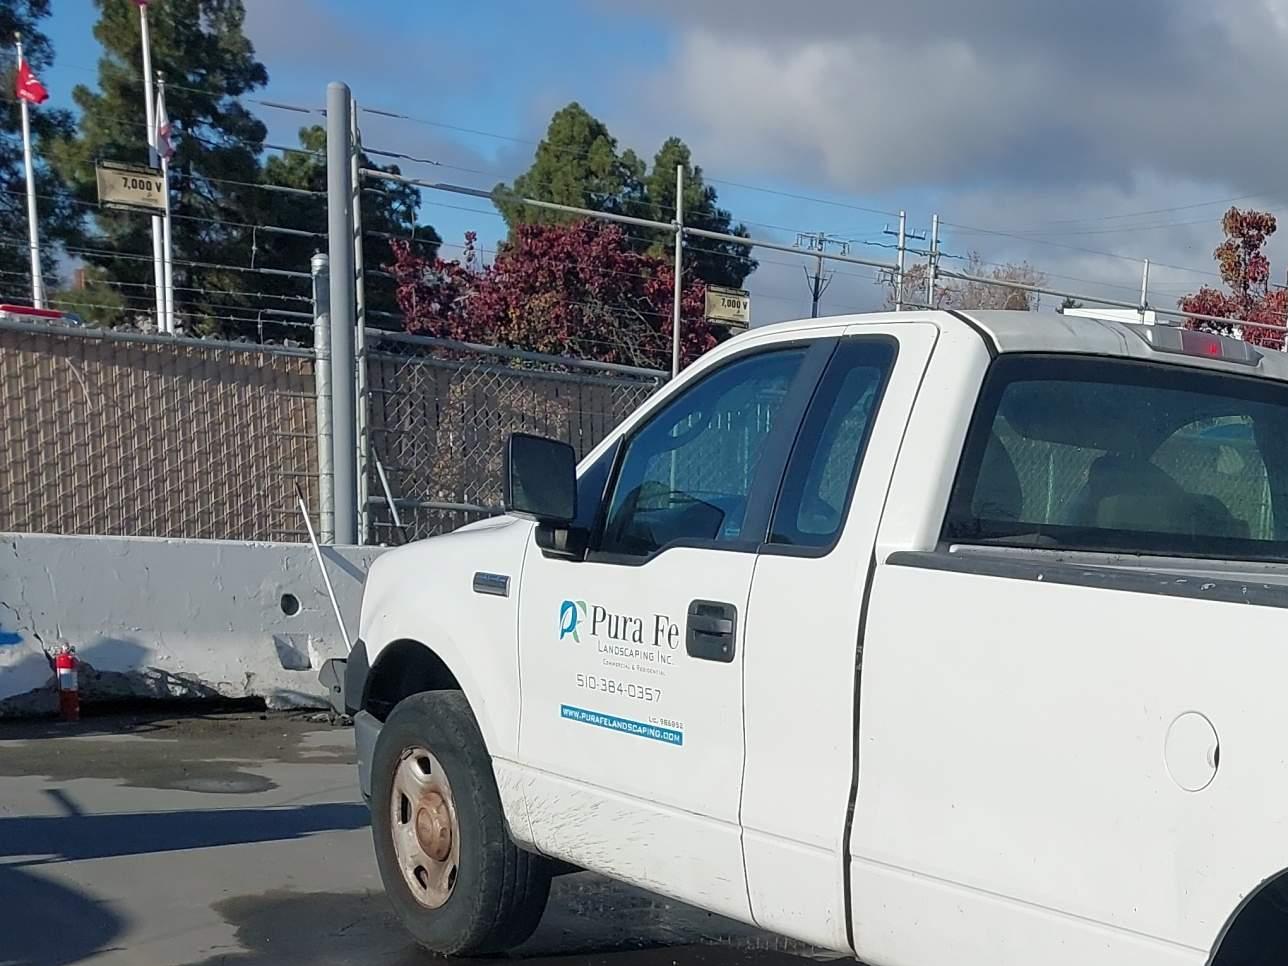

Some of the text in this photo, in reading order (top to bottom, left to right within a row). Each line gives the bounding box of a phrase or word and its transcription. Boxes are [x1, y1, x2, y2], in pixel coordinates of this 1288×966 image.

[121, 177, 162, 192] 7,000 V
[721, 298, 748, 310] 7,000 V
[590, 604, 679, 650] Pura Fe
[576, 674, 661, 702] 510-384-0357
